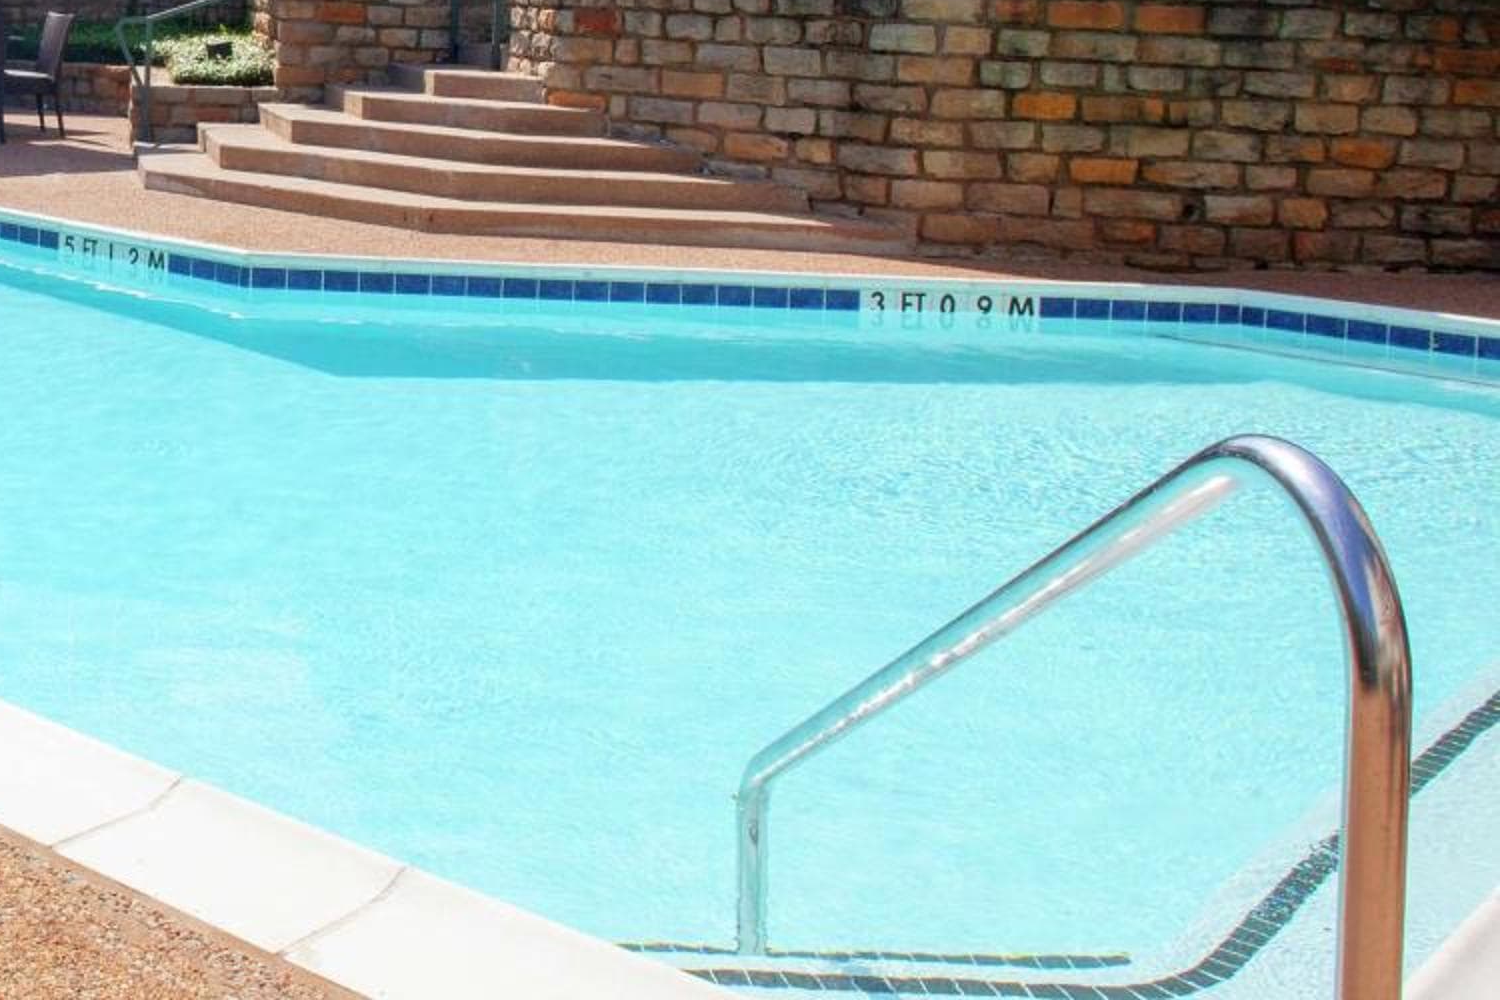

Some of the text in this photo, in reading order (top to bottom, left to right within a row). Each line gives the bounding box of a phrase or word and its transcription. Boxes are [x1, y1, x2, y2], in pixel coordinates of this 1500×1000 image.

[148, 250, 165, 269] M
[901, 292, 926, 312] FT
[1008, 296, 1034, 316] M
